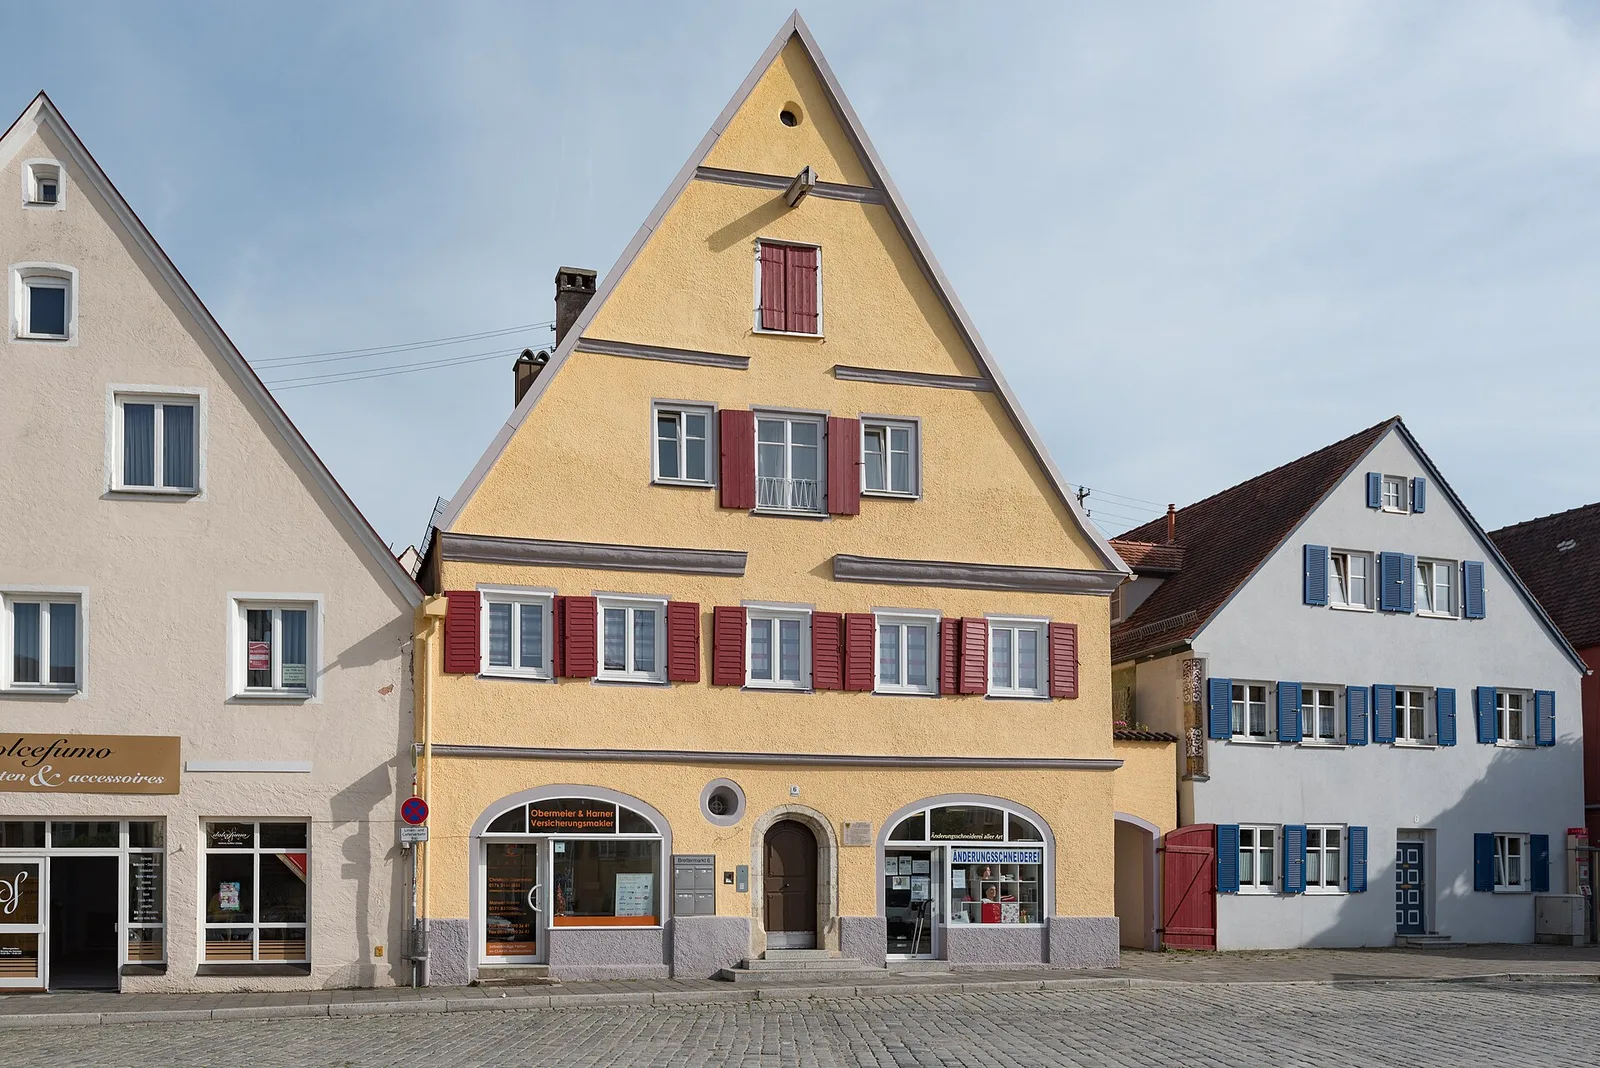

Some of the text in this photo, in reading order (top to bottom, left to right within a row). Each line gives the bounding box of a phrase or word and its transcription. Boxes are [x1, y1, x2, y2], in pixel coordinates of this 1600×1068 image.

[29, 765, 65, 787] &
[68, 772, 166, 785] accessoires
[530, 809, 614, 818] Obermeier & Harner
[530, 819, 614, 829] Versicherungsmakler
[930, 832, 983, 840] Änderungsschneiderei
[952, 849, 1040, 863] ÄNDERUNGSSCHNEIDEREI
